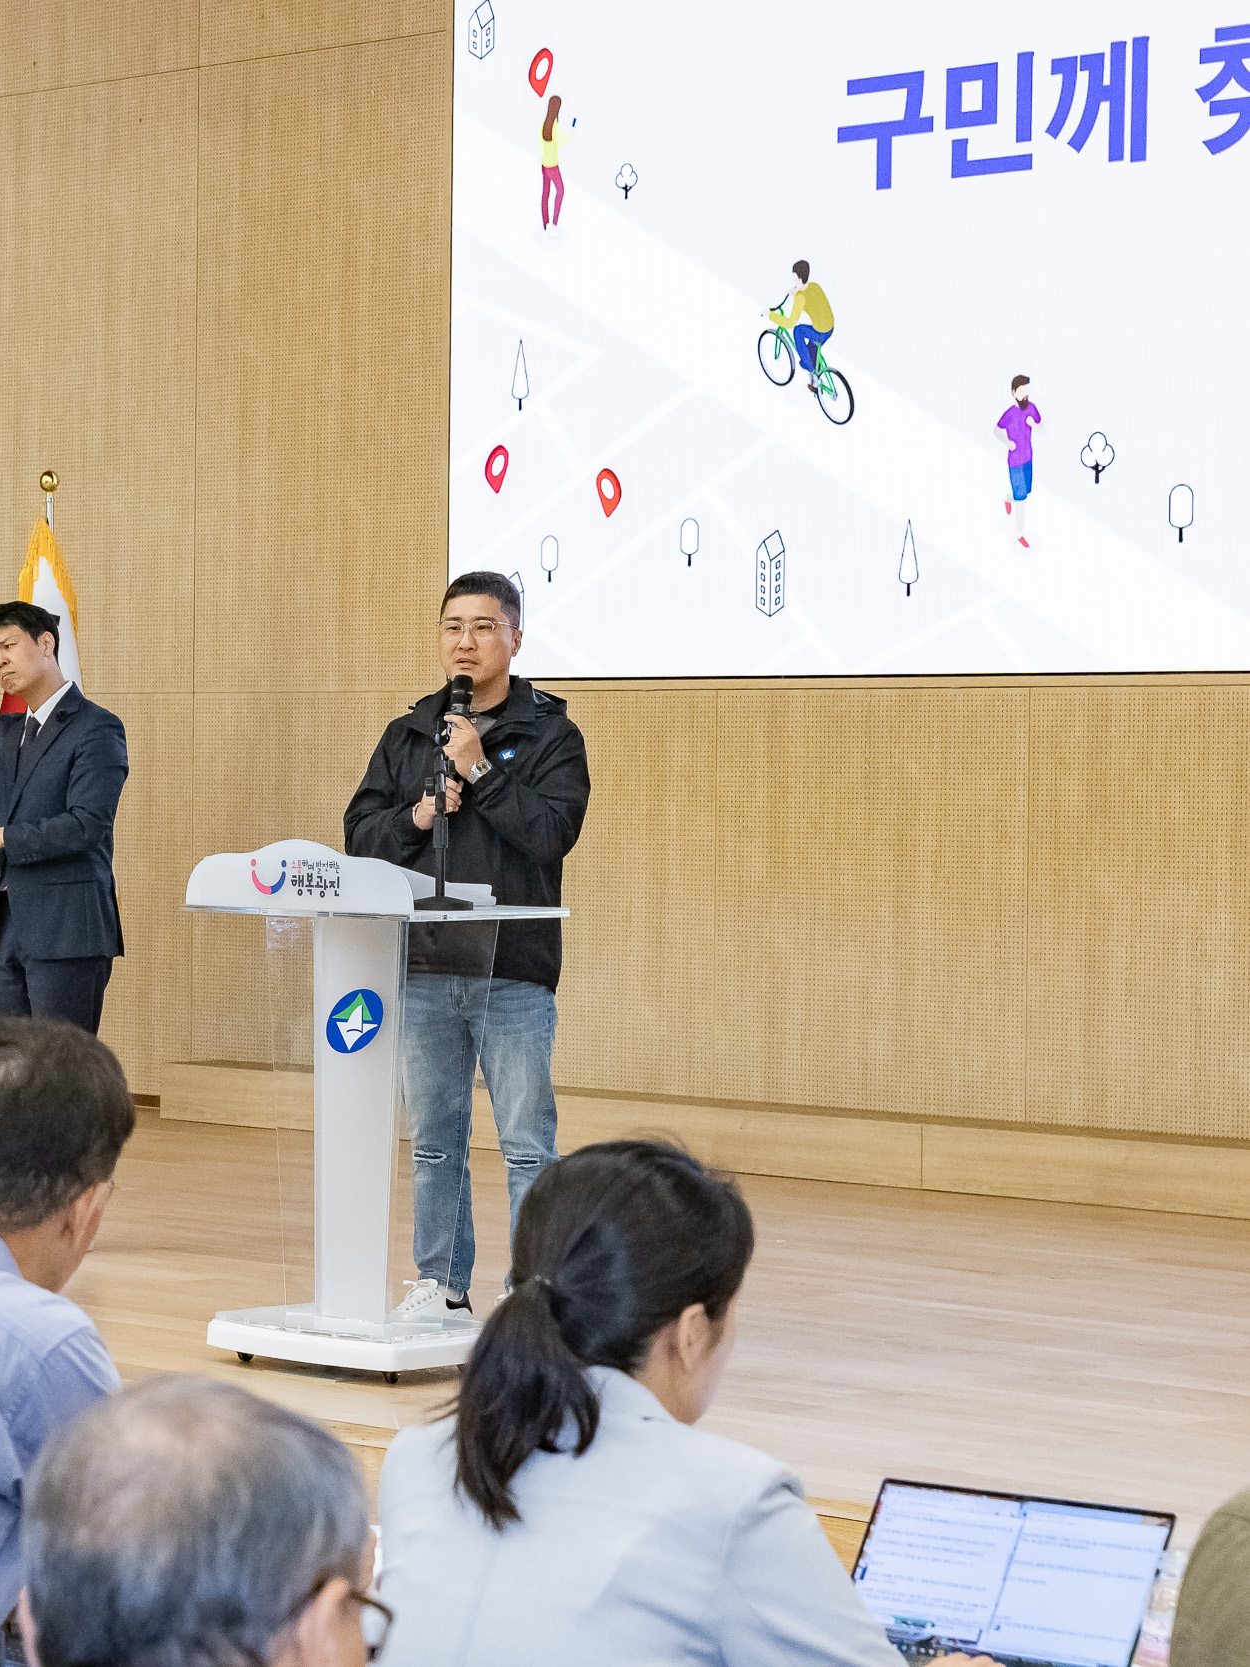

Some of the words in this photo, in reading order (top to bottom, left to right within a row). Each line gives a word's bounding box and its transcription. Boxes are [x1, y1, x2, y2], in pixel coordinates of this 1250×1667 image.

[838, 36, 1149, 190] 구민께
[291, 859, 314, 874] 소통하며
[315, 861, 340, 874] 발전하는
[291, 872, 340, 898] 행복광진
